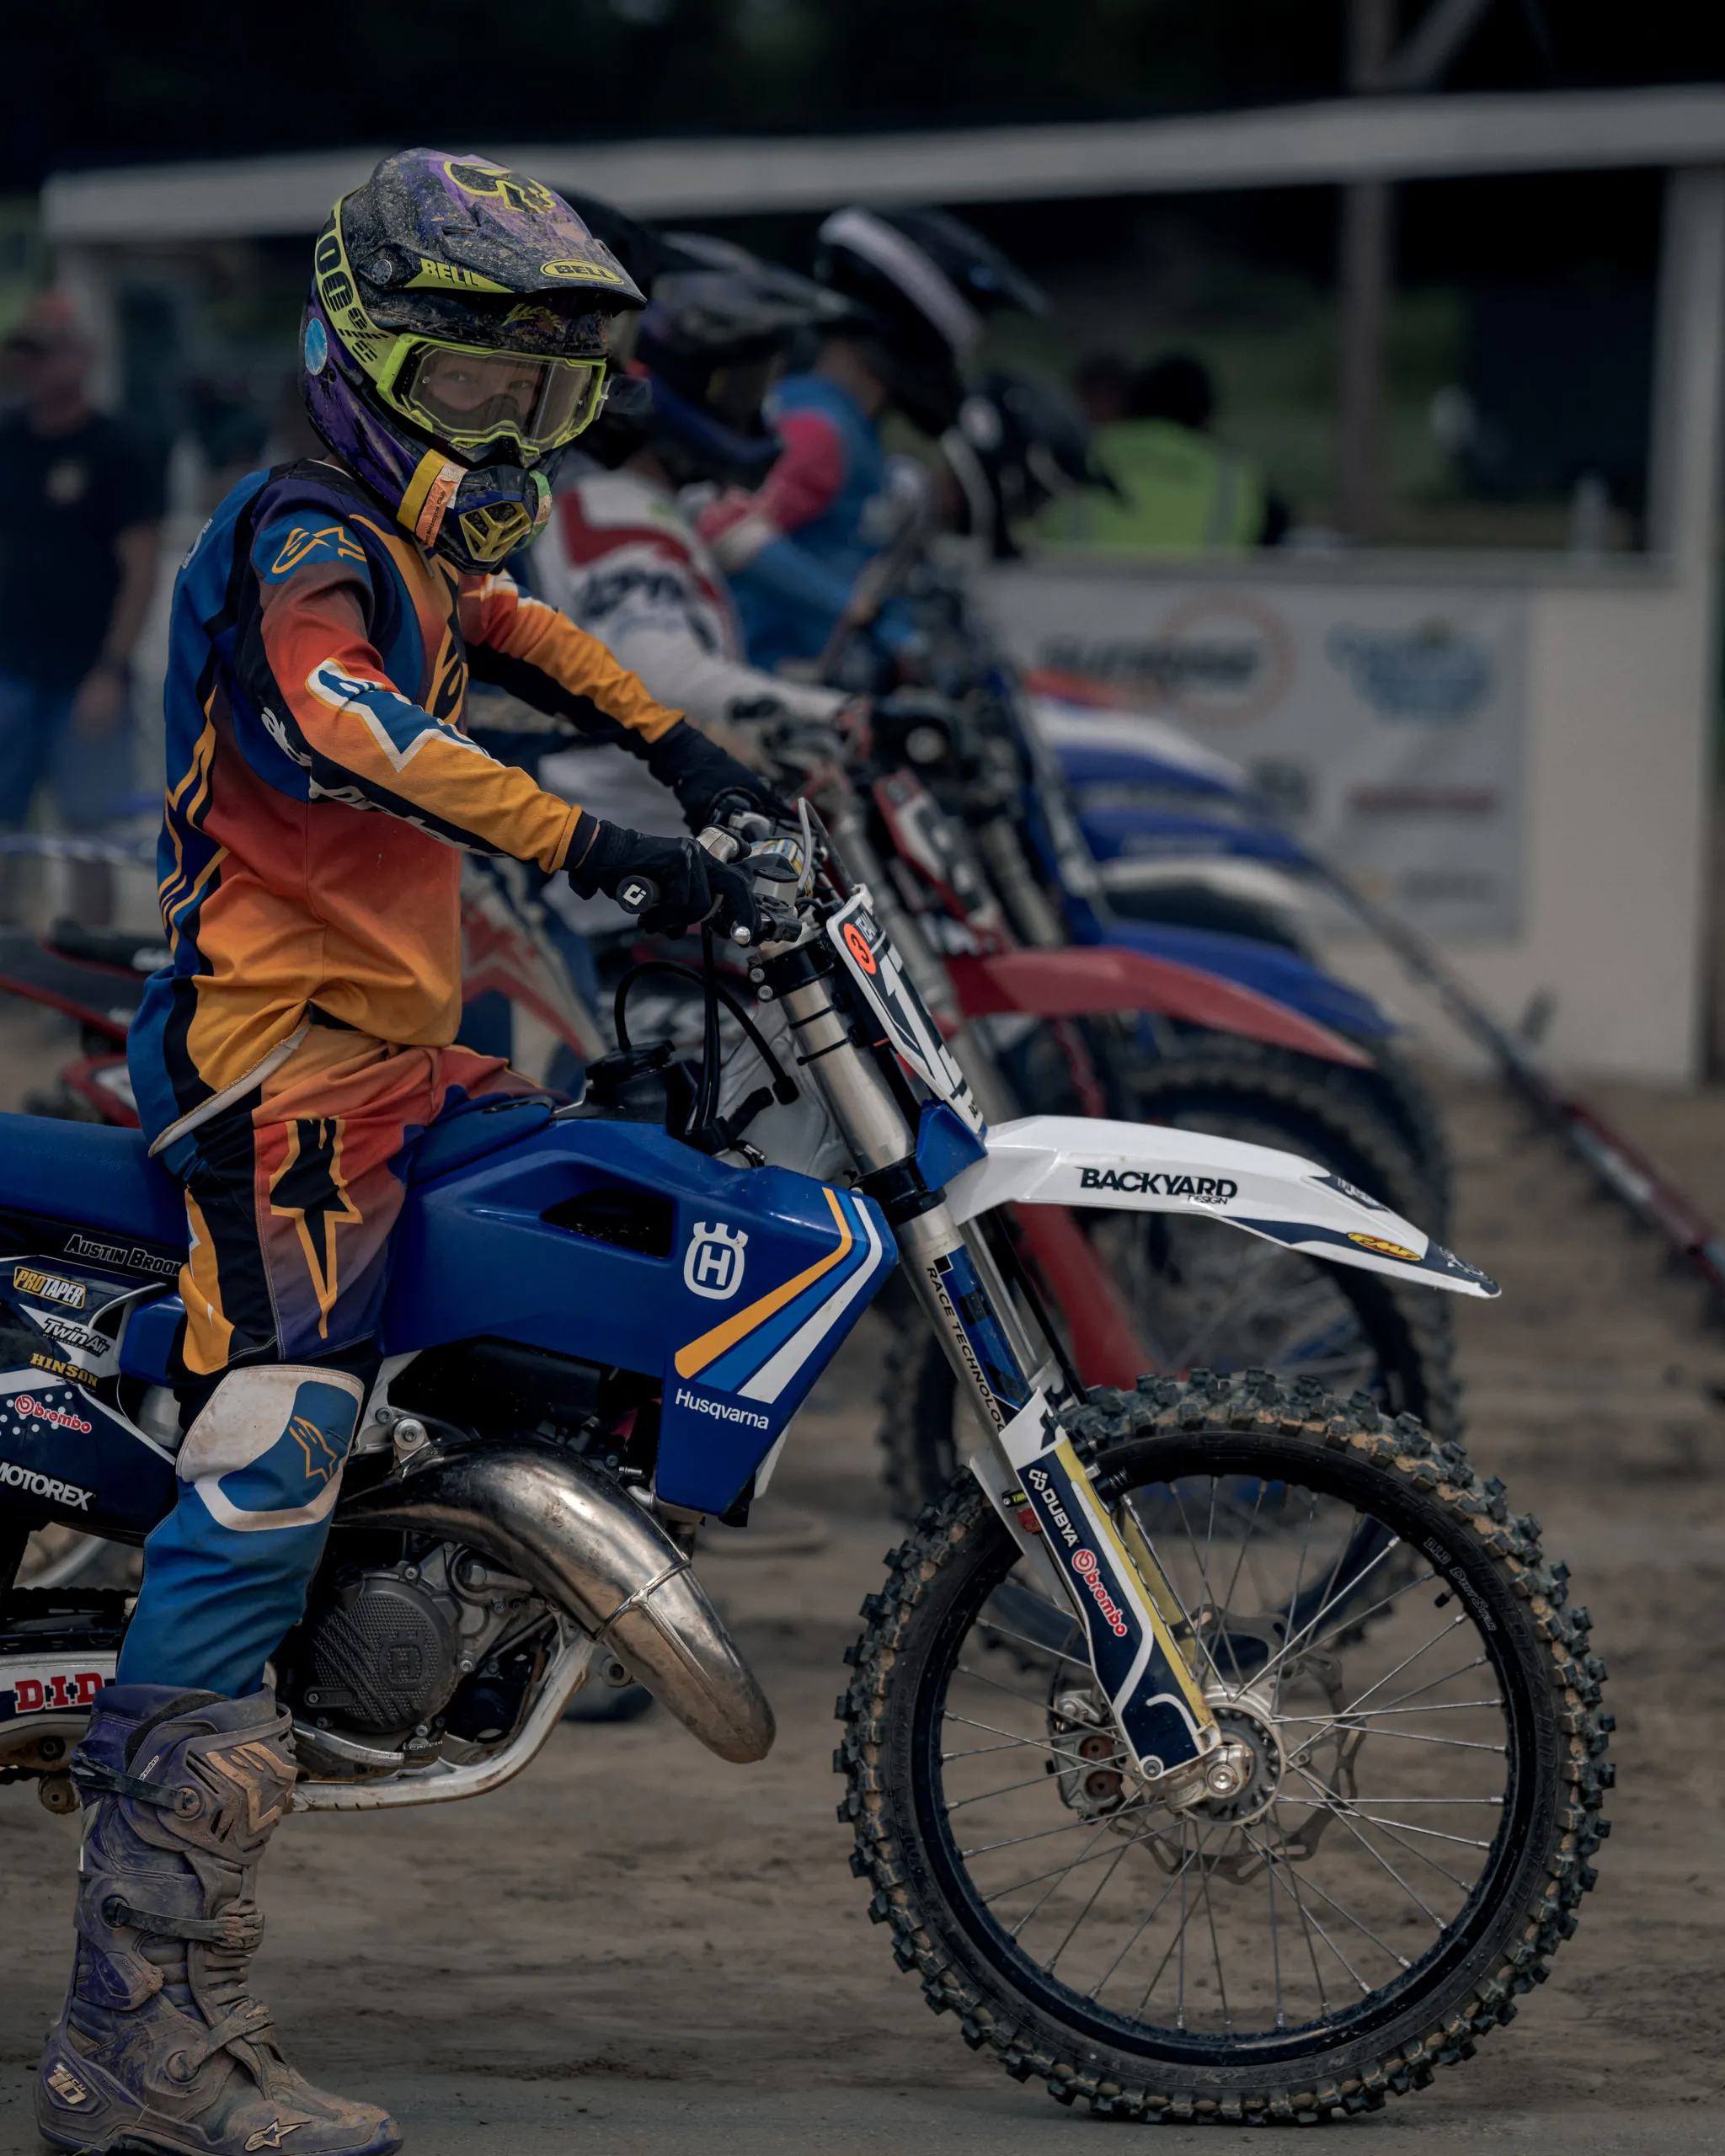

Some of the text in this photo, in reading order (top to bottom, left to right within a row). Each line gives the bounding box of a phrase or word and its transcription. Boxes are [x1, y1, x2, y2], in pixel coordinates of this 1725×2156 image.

[420, 258, 479, 287] BELL
[554, 264, 614, 280] BELL
[436, 490, 446, 504] Club
[850, 934, 869, 963] 3
[1075, 1166, 1237, 1198] BACKYARD
[1187, 1194, 1228, 1205] DESIGN
[63, 1233, 128, 1264] AUSTIN
[926, 1267, 955, 1317] RACE
[44, 1318, 88, 1345] Twin
[86, 1335, 110, 1354] Air
[29, 1353, 99, 1388] HINSON
[33, 1401, 92, 1434] brembo
[675, 1388, 770, 1430] Husqvarna
[1041, 1487, 1079, 1549] DUBYA
[1082, 1567, 1128, 1637] brembo
